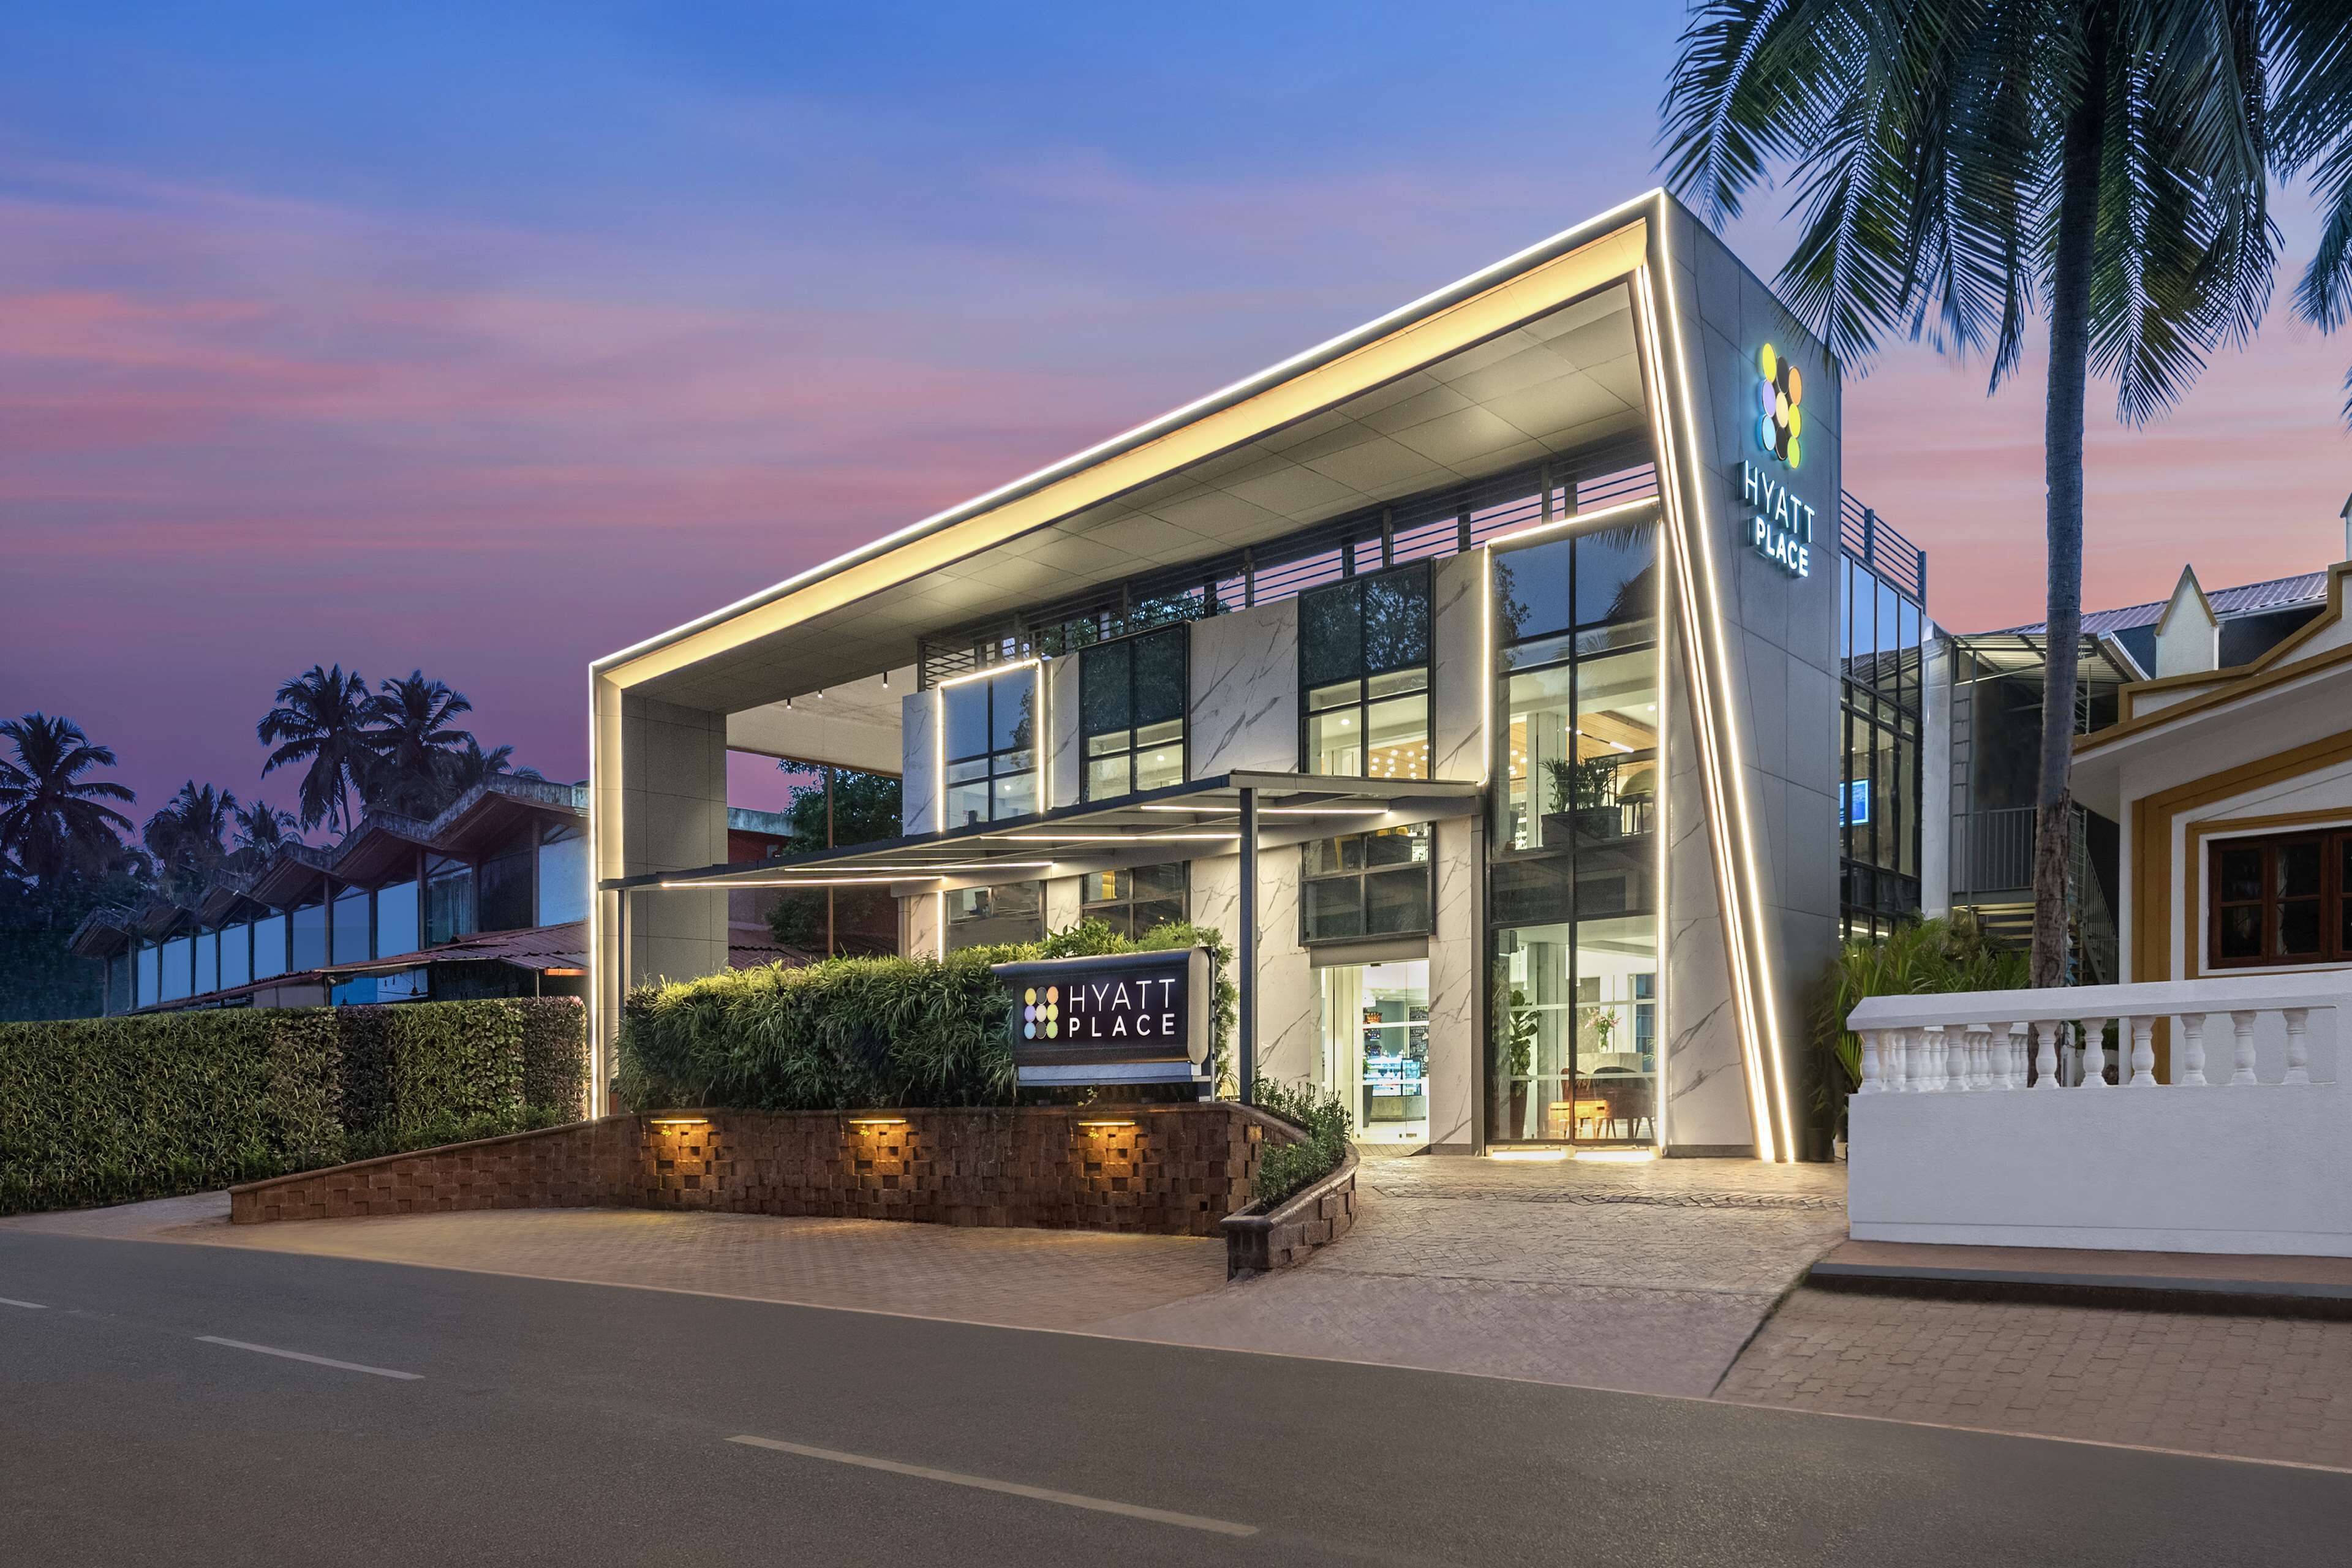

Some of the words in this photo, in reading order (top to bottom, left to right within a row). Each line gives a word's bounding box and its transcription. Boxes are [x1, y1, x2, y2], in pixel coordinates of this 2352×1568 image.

[1745, 460, 1815, 543] HYATT
[1755, 516, 1809, 578] PLACE
[1069, 978, 1176, 1013] HYATT
[1069, 1013, 1175, 1038] PLACE
